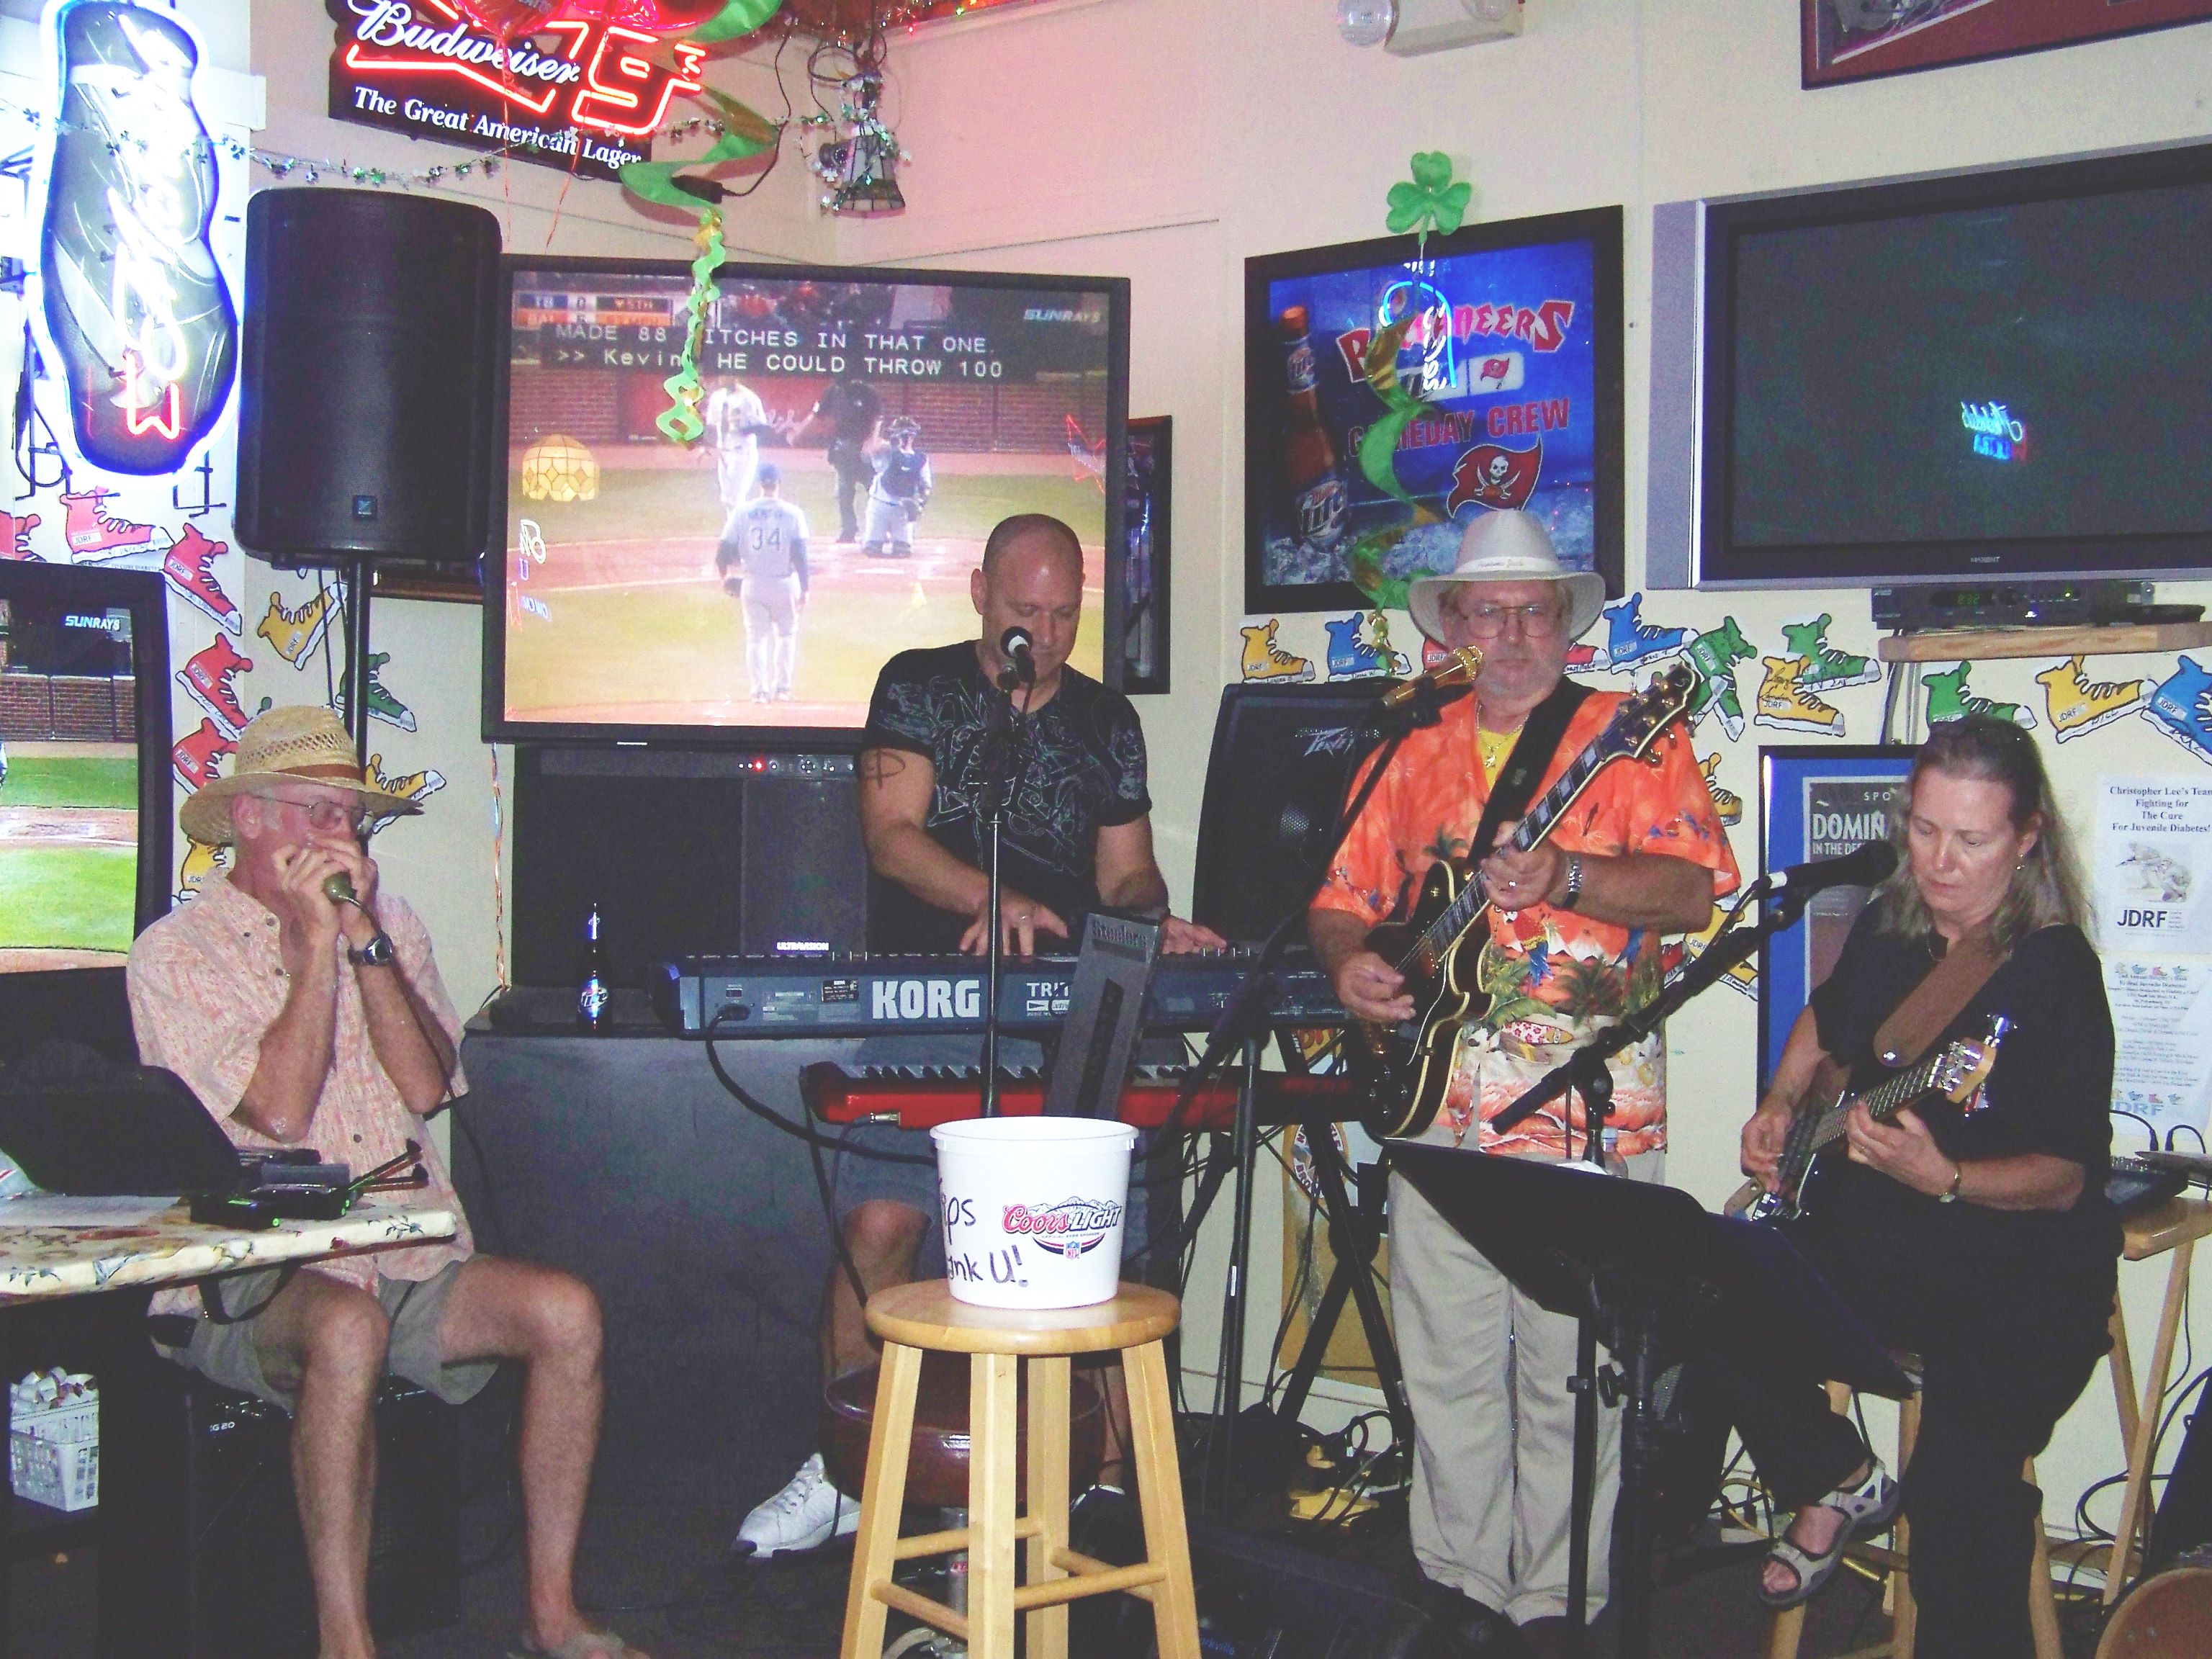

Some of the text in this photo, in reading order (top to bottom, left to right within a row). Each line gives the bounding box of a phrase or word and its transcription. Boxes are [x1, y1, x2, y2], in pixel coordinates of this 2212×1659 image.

[341, 0, 580, 84] Budweiser
[354, 86, 642, 171] The Great American Lager
[1023, 308, 1102, 324] SUNRAYS
[555, 325, 994, 354] MADE 88 ITCHES IN THAT ONE.
[717, 353, 747, 370] HE
[766, 354, 845, 373] COULD
[864, 356, 942, 375] THROW
[960, 360, 1002, 378] 100
[1348, 397, 1570, 457] GEDAY CREW
[750, 526, 781, 551] 34
[65, 615, 120, 631] SUNRAYS
[1763, 700, 1783, 709] JDRF
[2059, 708, 2077, 722] JDRF
[2109, 786, 2162, 796] Christopher
[2164, 786, 2189, 796] Lee's
[2135, 799, 2189, 809] Fighting for
[1812, 811, 1888, 840] DOMIN
[2141, 811, 2183, 820] The Cure
[2112, 822, 2211, 833] For Juvenile Diabetes!
[1812, 842, 1823, 855] IN
[1825, 842, 1843, 855] THE
[2117, 909, 2167, 929] JDRF
[871, 979, 980, 1020] KORG
[1002, 1203, 1123, 1234] Coors LIGHT
